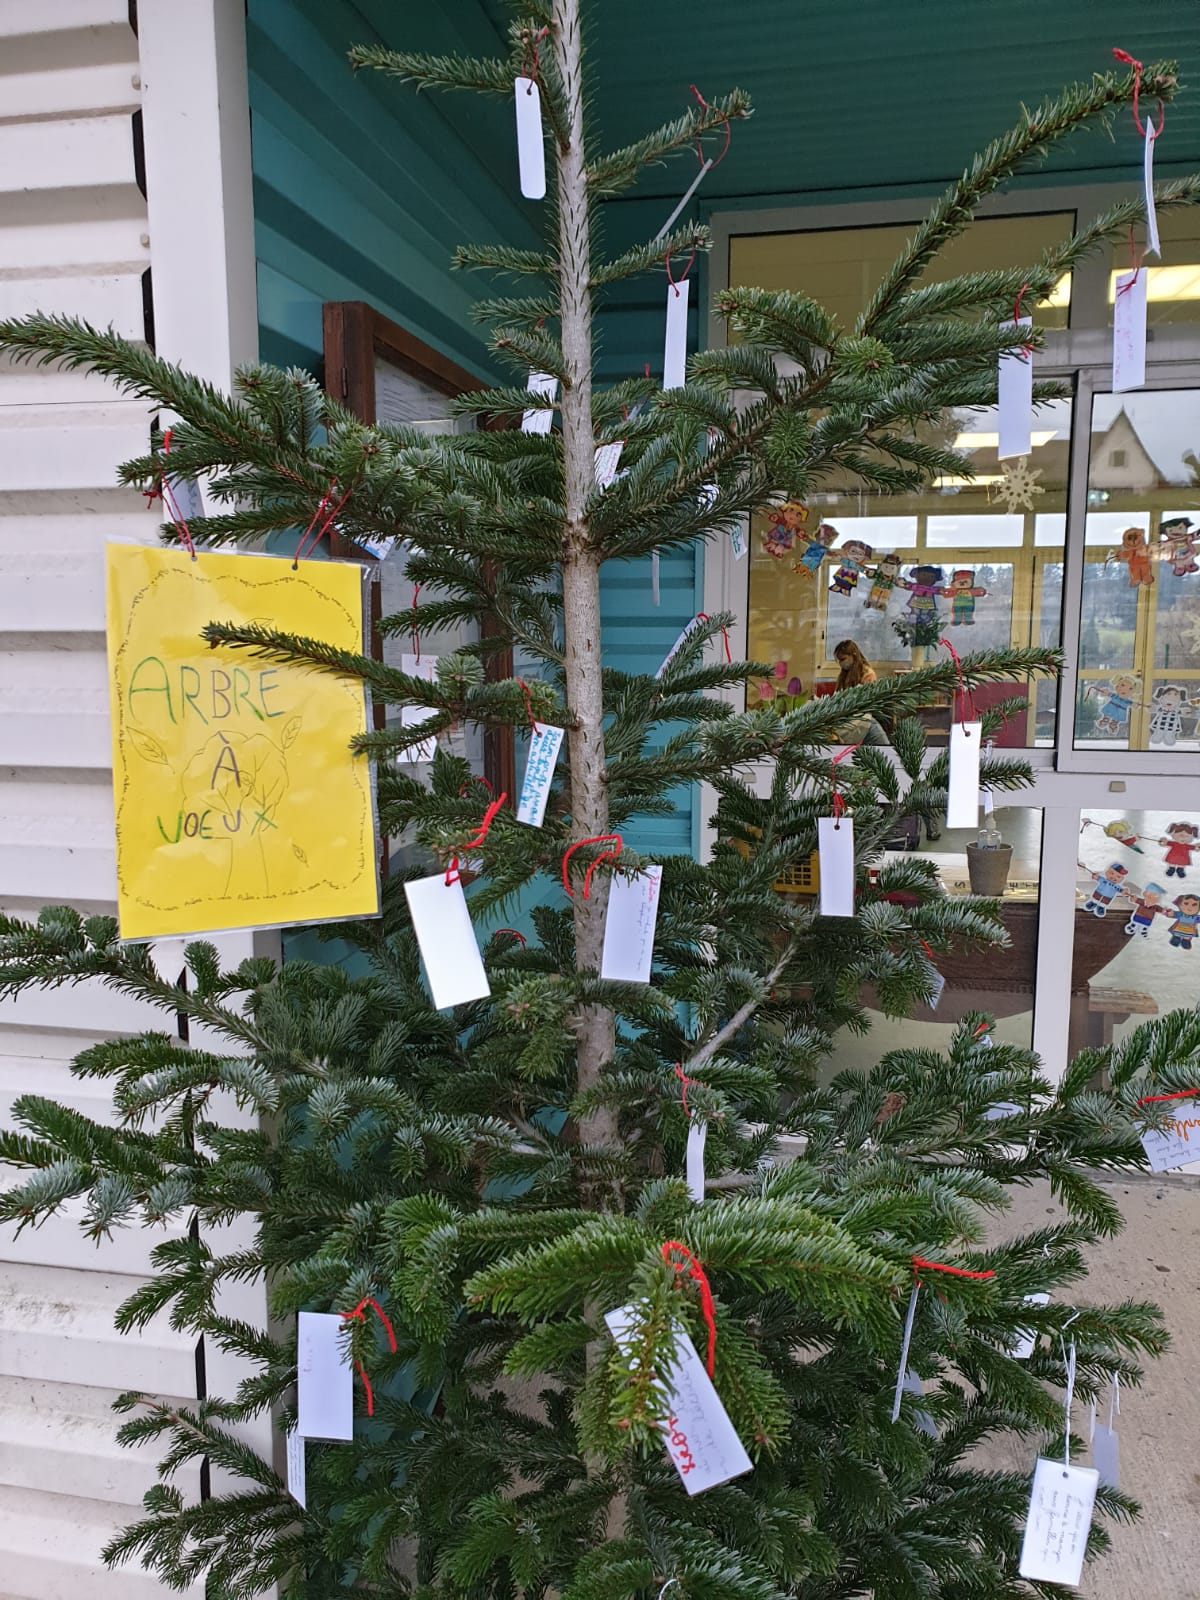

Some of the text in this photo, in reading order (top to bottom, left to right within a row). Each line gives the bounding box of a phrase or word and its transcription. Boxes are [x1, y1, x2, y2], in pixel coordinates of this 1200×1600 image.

[128, 656, 286, 725] ARBRE
[211, 730, 241, 790] À
[157, 804, 278, 844] VOEUX
